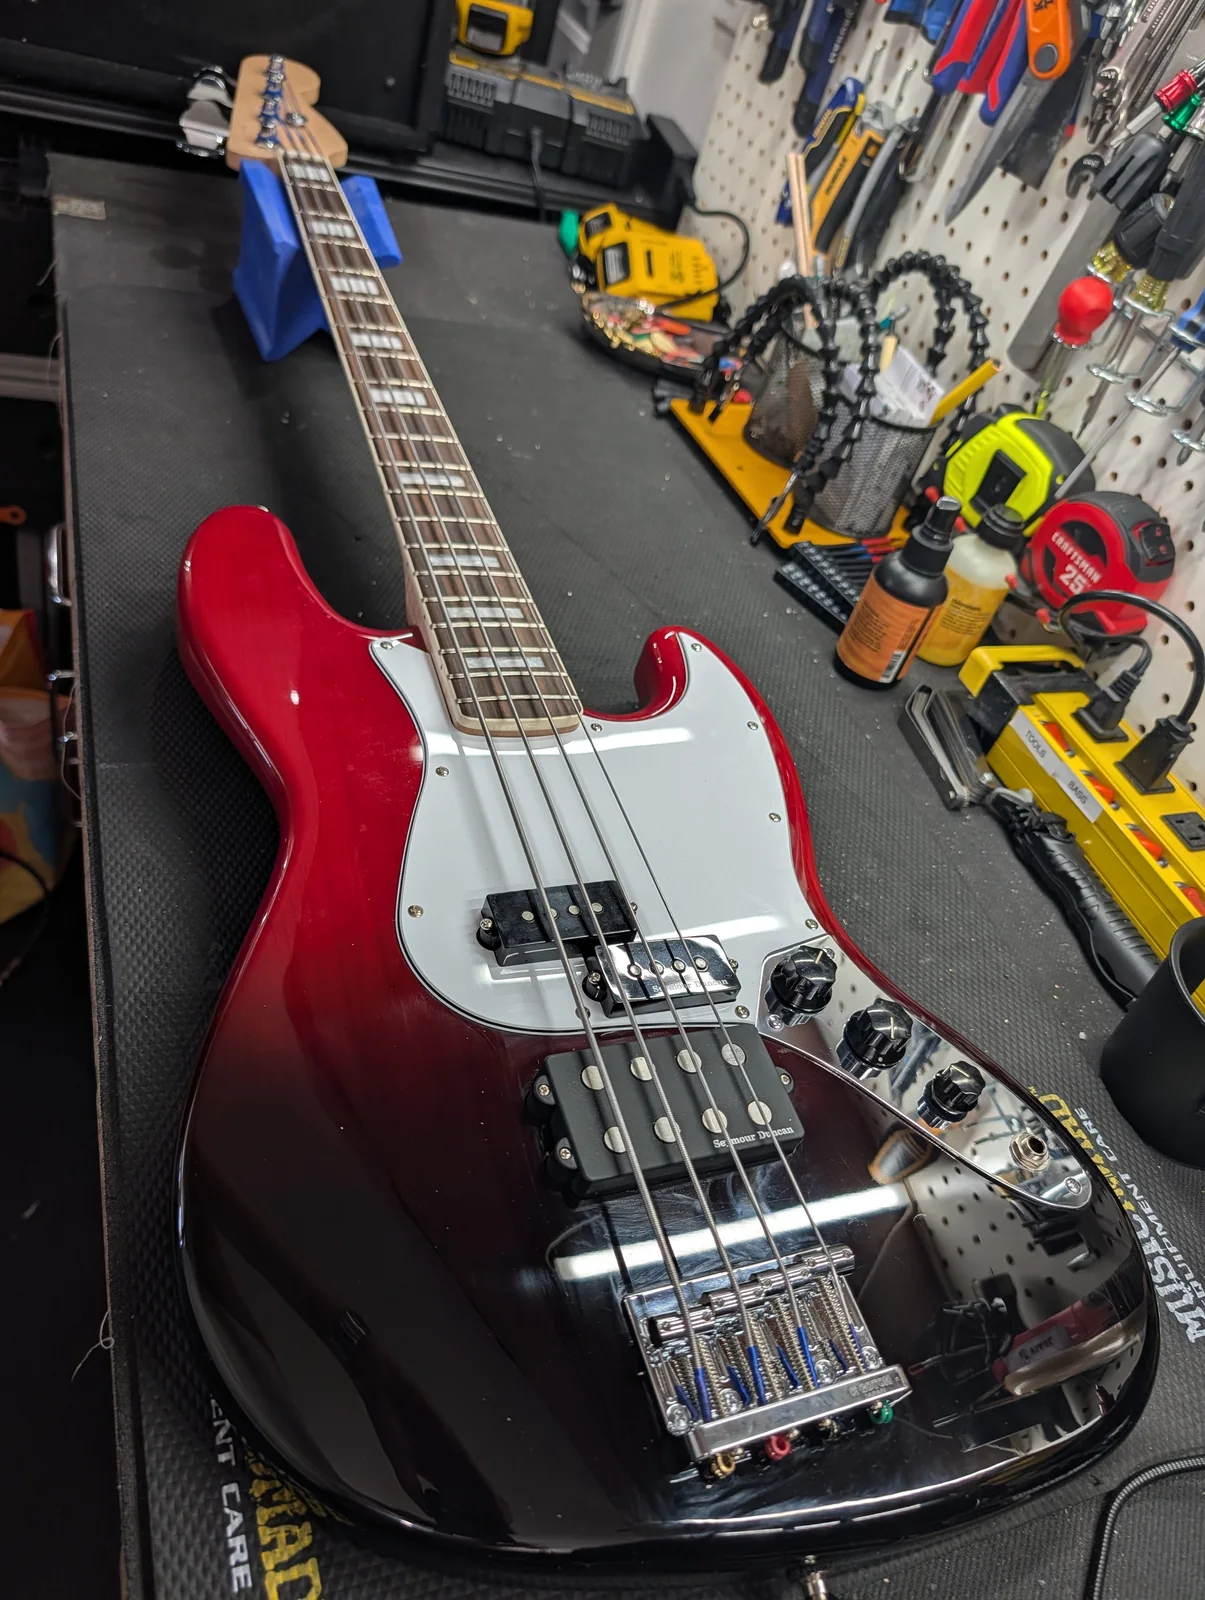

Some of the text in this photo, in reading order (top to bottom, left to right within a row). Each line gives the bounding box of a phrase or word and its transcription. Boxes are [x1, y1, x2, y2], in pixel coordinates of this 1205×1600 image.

[1051, 531, 1102, 584] CRAFTSMAN
[1025, 729, 1047, 759] TOOLS
[1067, 780, 1089, 805] BASS
[1074, 1107, 1118, 1162] CARE
[221, 1482, 253, 1594] CARE
